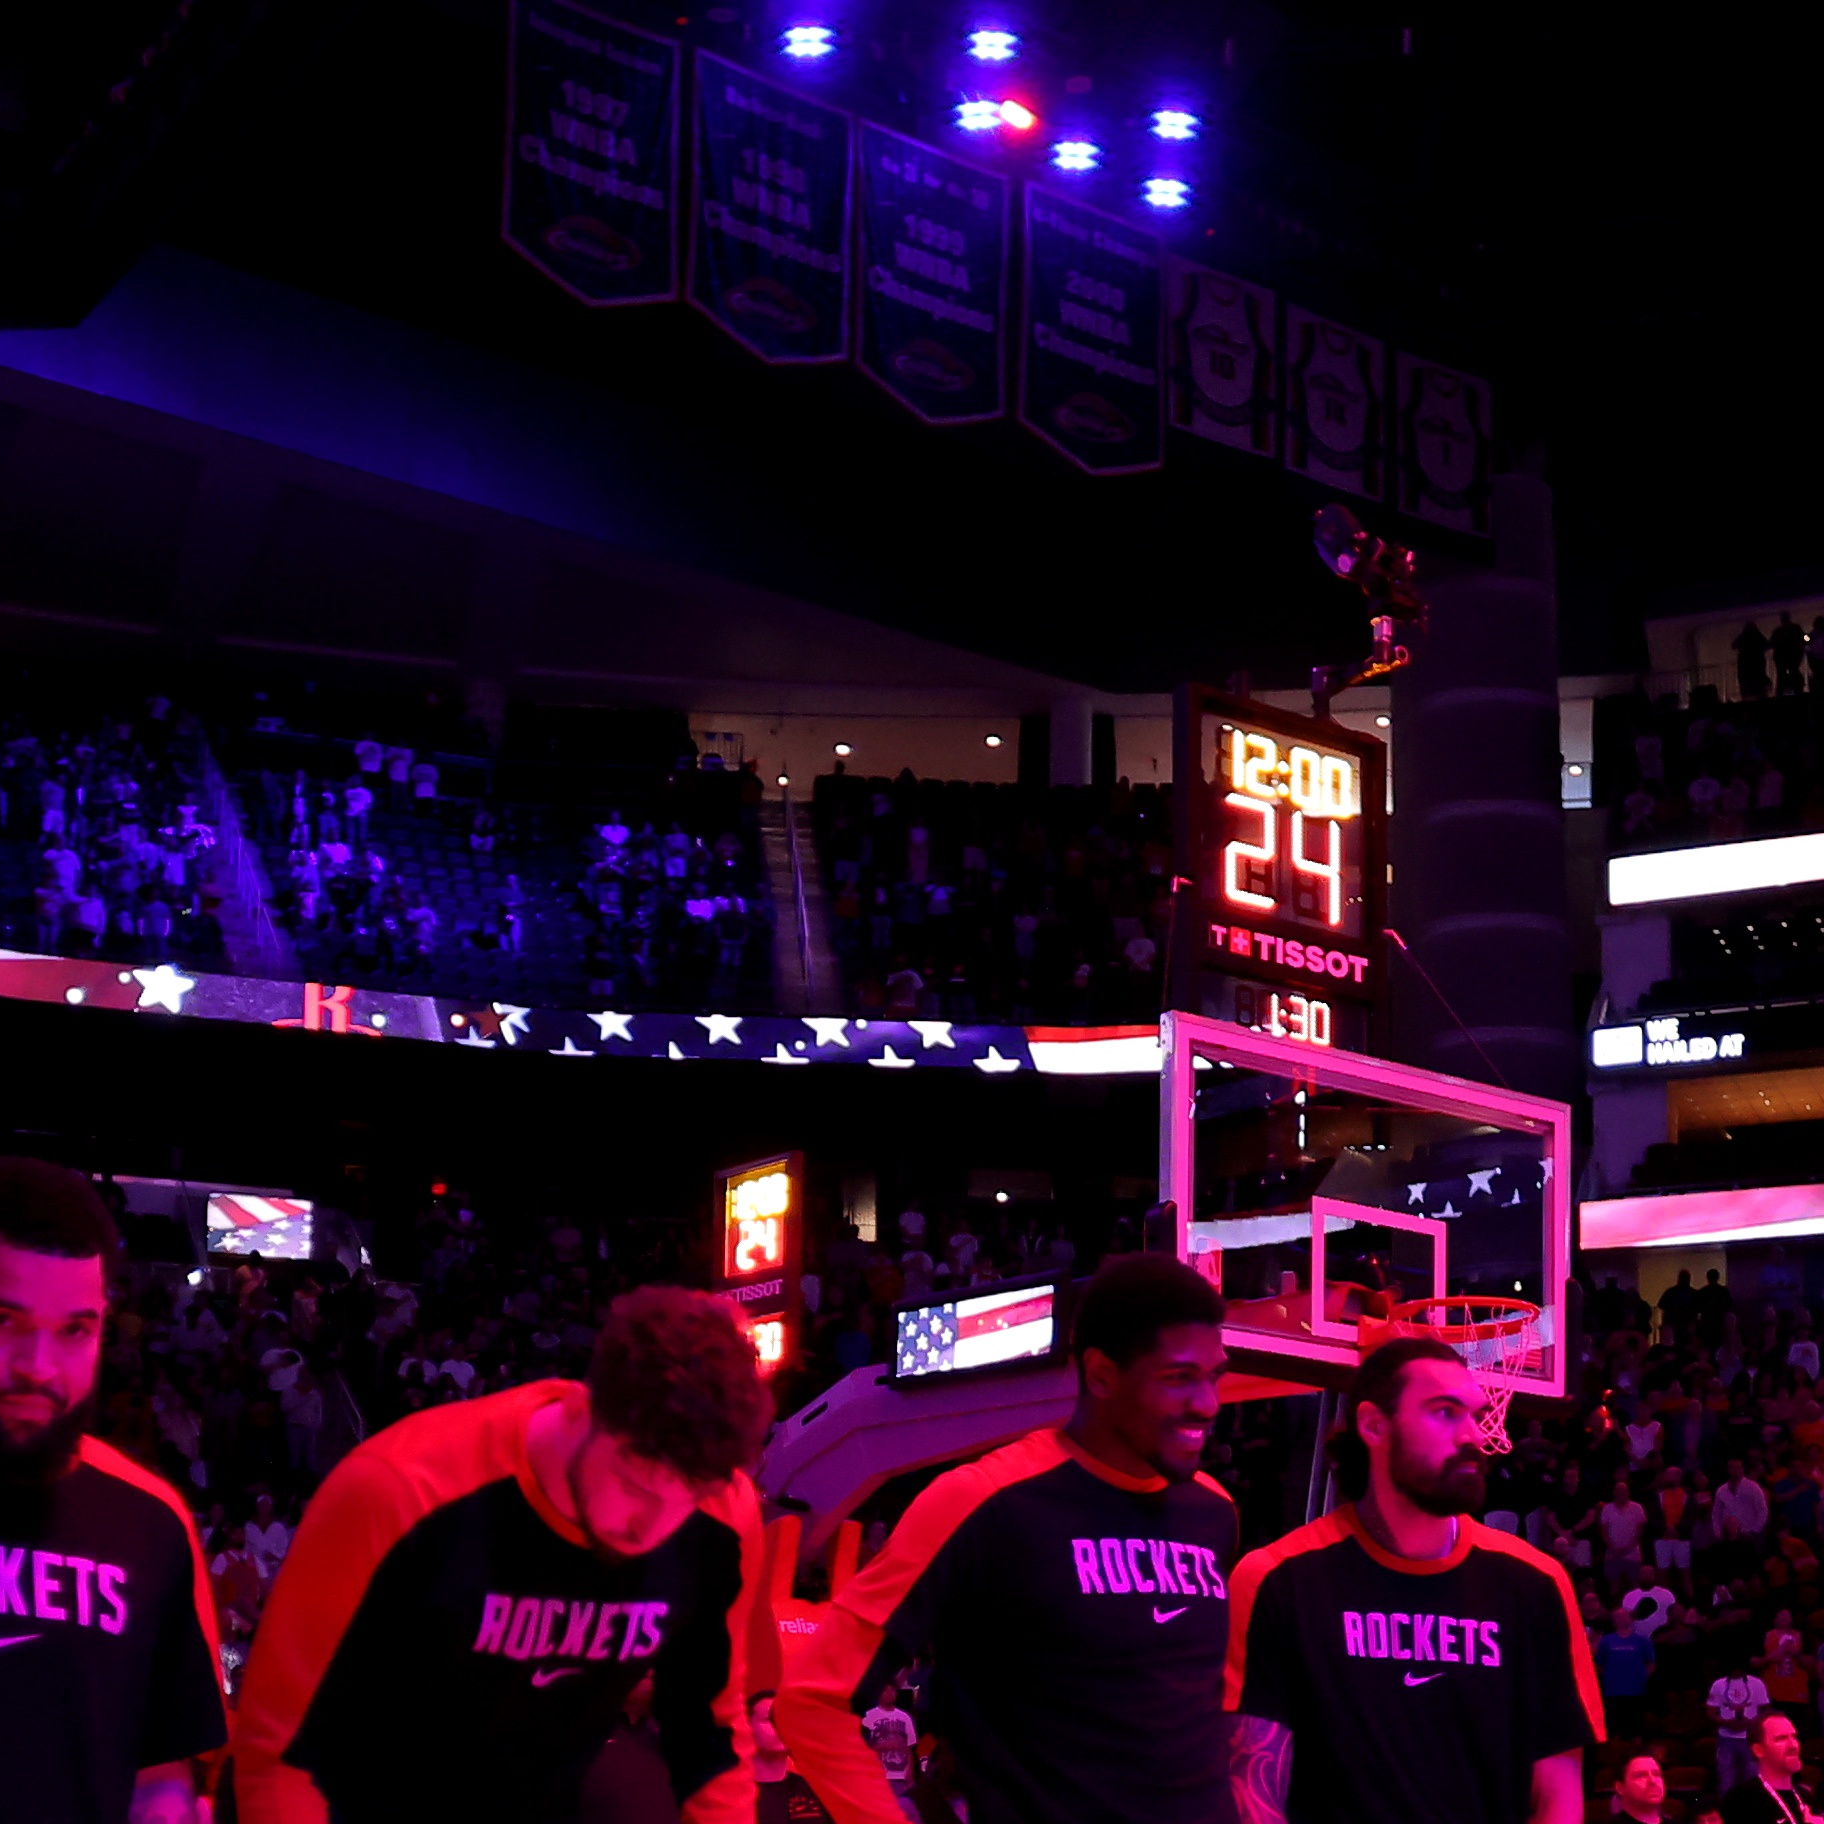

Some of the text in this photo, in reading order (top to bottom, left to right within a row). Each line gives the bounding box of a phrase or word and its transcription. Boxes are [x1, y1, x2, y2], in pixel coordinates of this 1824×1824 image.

[1230, 728, 1353, 820] 12:00
[1222, 792, 1343, 926] 24
[1253, 934, 1369, 984] TISSOT
[735, 1217, 777, 1270] 24
[1071, 1538, 1227, 1600] ROCKETS
[471, 1594, 671, 1663] ROCKETS
[778, 1617, 819, 1635] relia
[1343, 1611, 1502, 1668] ROCKETS
